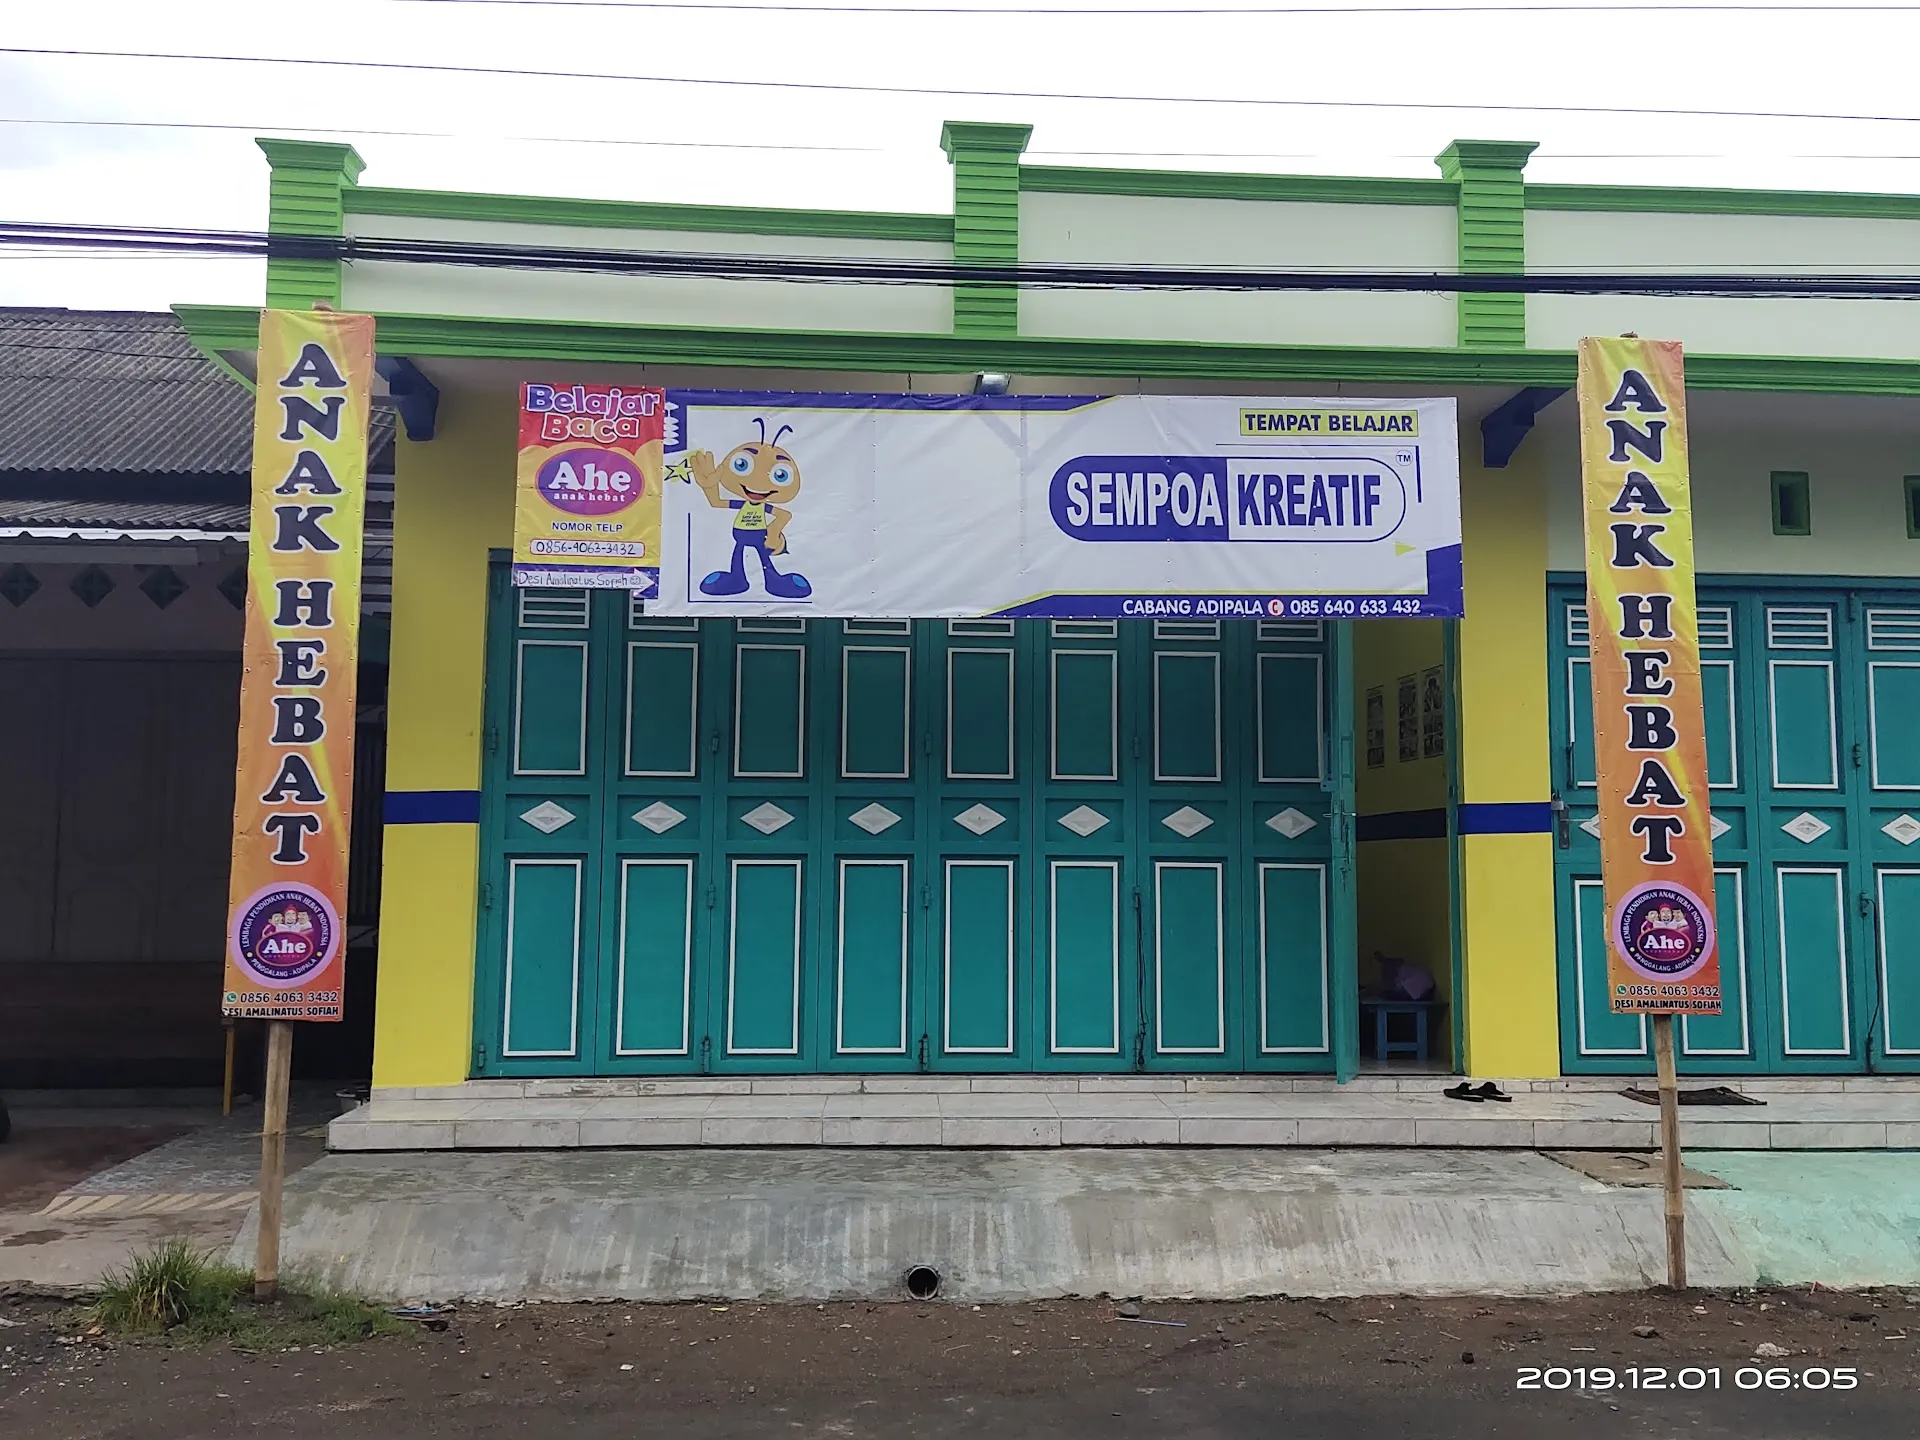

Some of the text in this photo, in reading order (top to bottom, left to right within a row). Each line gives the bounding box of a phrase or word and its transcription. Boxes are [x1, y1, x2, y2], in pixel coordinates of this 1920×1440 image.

[527, 384, 660, 421] Belajar
[541, 412, 639, 443] Baca
[1245, 414, 1414, 432] TEMPAT BELAJAR
[271, 342, 349, 552] ANAK
[1397, 454, 1411, 463] TM
[548, 461, 632, 492] Ahe
[553, 491, 626, 502] anak hebat
[1066, 471, 1381, 527] SEMPOA KREATIF
[551, 522, 623, 533] NOMOR TELP
[536, 541, 637, 555] 0856-4063-3432
[518, 571, 543, 585] Desi
[1122, 599, 1422, 615] CABANG ADIPALA 085 640 633 432
[1604, 369, 1687, 864] ANAK HEBAT
[260, 579, 335, 864] HEBAT
[241, 893, 329, 948] LEMBAGA PENDIDIKAN ANAK HEBAT INDONESIA
[1622, 891, 1704, 943] LEMBAGA PENDIDIKAN ANAK HEBAT INDONESIA
[262, 938, 307, 954] Ahe
[1643, 934, 1685, 949] Ahe
[250, 958, 288, 977] PENGGALANG
[292, 958, 317, 976] ADIPALA
[1634, 953, 1671, 971] PENGGALANG
[1674, 954, 1696, 970] ADIPALA
[240, 991, 338, 1003] 0856 4063 3432
[1629, 985, 1720, 997] 0856 4063 3432
[245, 1007, 304, 1016] AMALINATUS
[306, 1006, 339, 1016] SOFIAH
[1615, 999, 1722, 1009] DESI AMALINATUS SOFIAH
